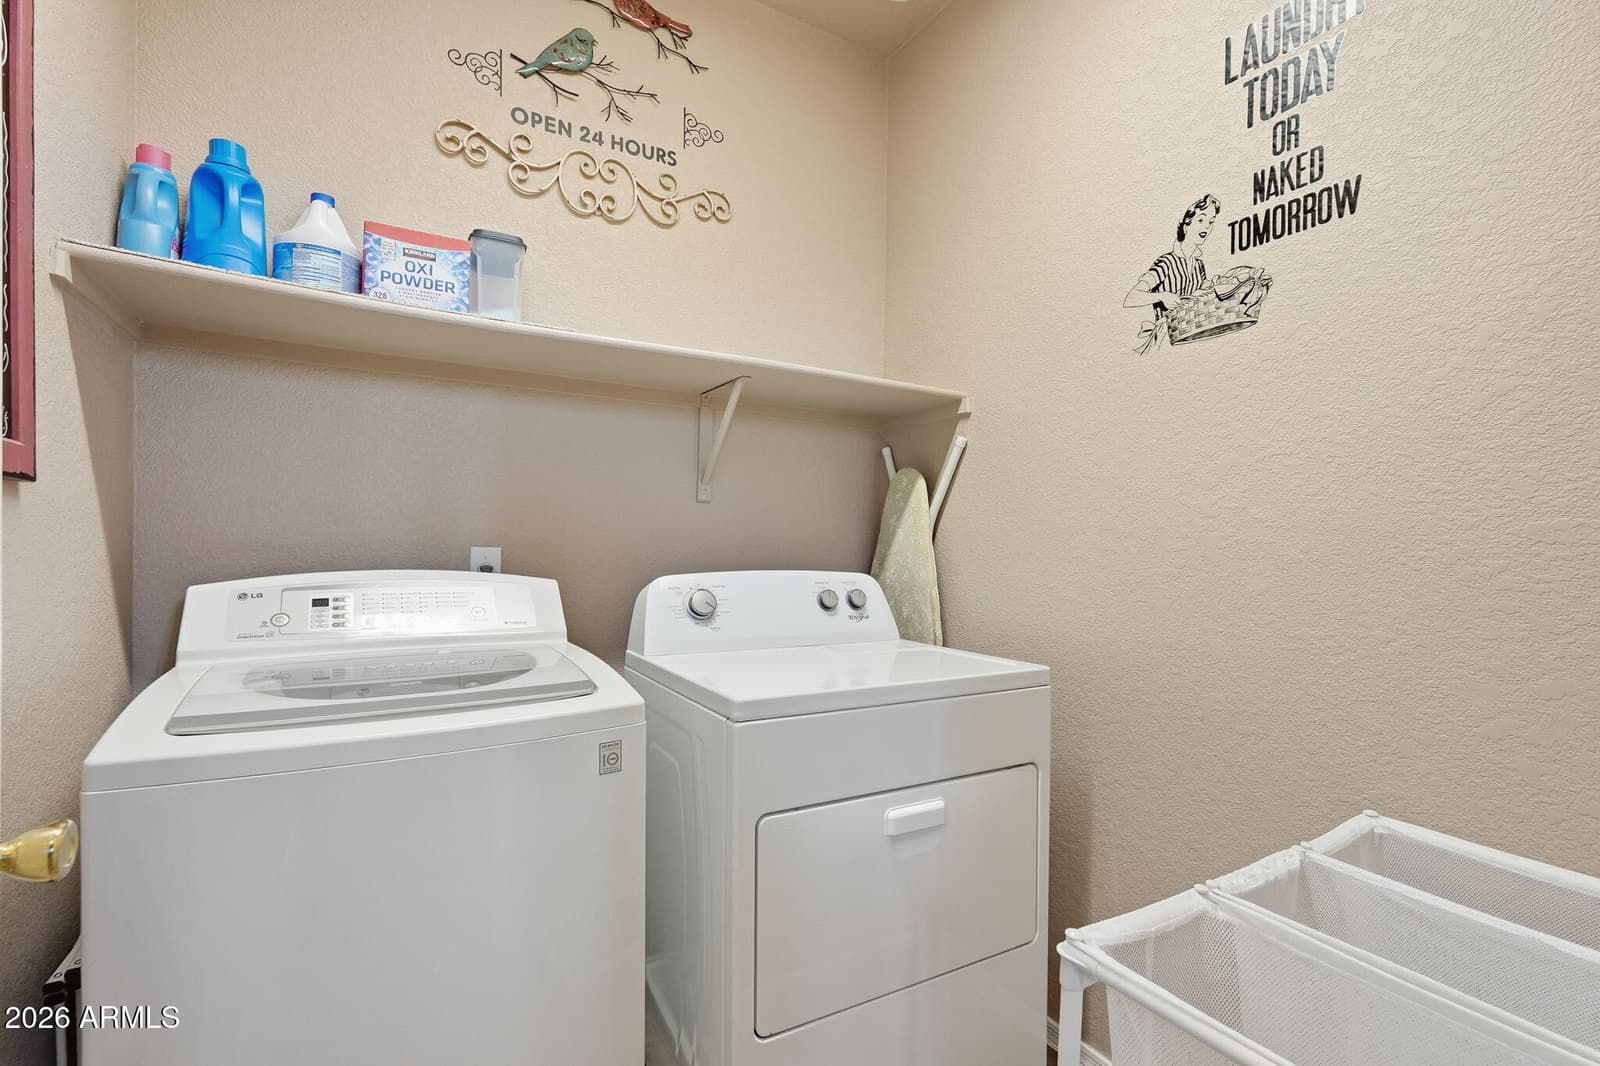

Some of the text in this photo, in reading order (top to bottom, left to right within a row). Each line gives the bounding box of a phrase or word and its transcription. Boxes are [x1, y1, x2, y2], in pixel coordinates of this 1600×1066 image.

[1224, 0, 1366, 85] LAUNDR
[1242, 31, 1345, 129] TODAY
[510, 106, 678, 167] OPEN 24 HOURS
[1272, 113, 1301, 156] OR
[1253, 145, 1325, 205] NAKED
[1228, 174, 1362, 255] TOMORROW
[373, 290, 387, 300] 328
[380, 270, 455, 294] POWDER
[405, 260, 433, 276] OXI
